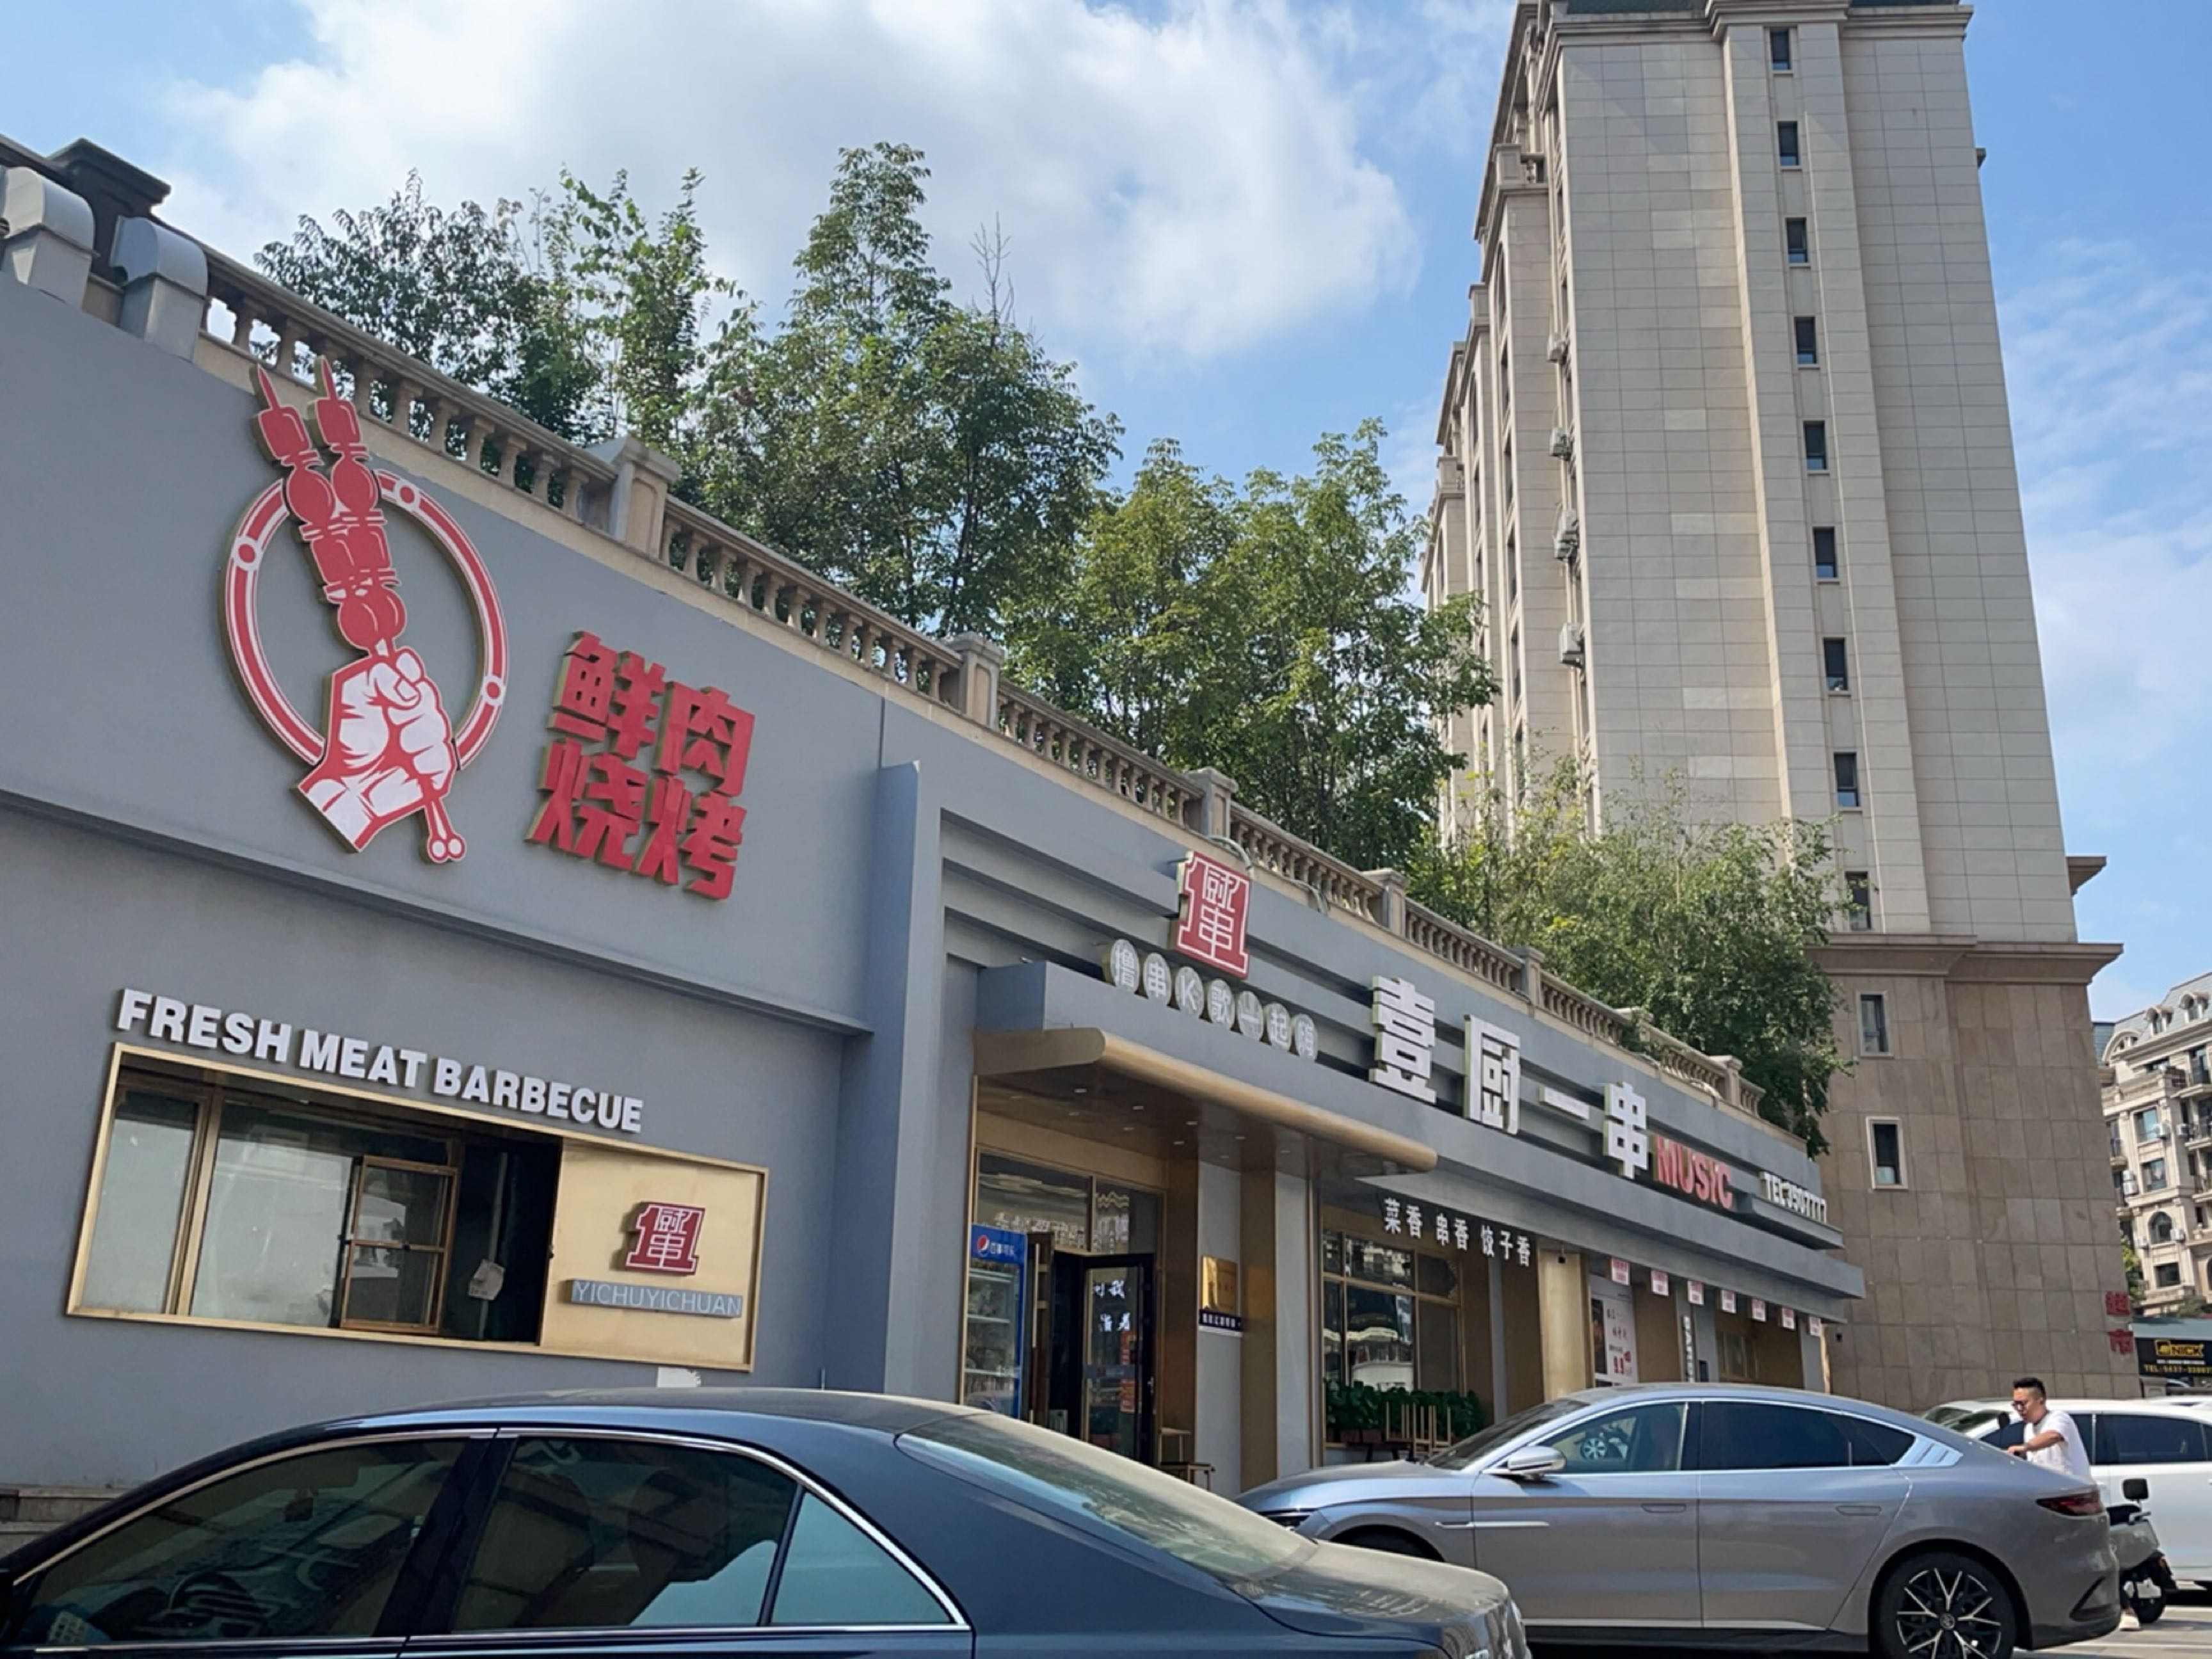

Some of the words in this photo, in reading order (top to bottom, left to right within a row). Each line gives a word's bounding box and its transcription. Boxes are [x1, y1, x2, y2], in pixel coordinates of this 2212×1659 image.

[549, 630, 755, 796] 鲜肉
[525, 737, 748, 900] 烧烤
[116, 988, 293, 1062] FRESH
[299, 1029, 428, 1087] MEAT
[433, 1057, 643, 1134] BARBECUE
[1370, 975, 1649, 1179] 壹厨一串
[1383, 1197, 1423, 1240] 菜香
[1436, 1212, 1470, 1251] 串香
[1656, 1135, 1733, 1209] MUSIC
[575, 1281, 742, 1316] YICHUYICHUAN
